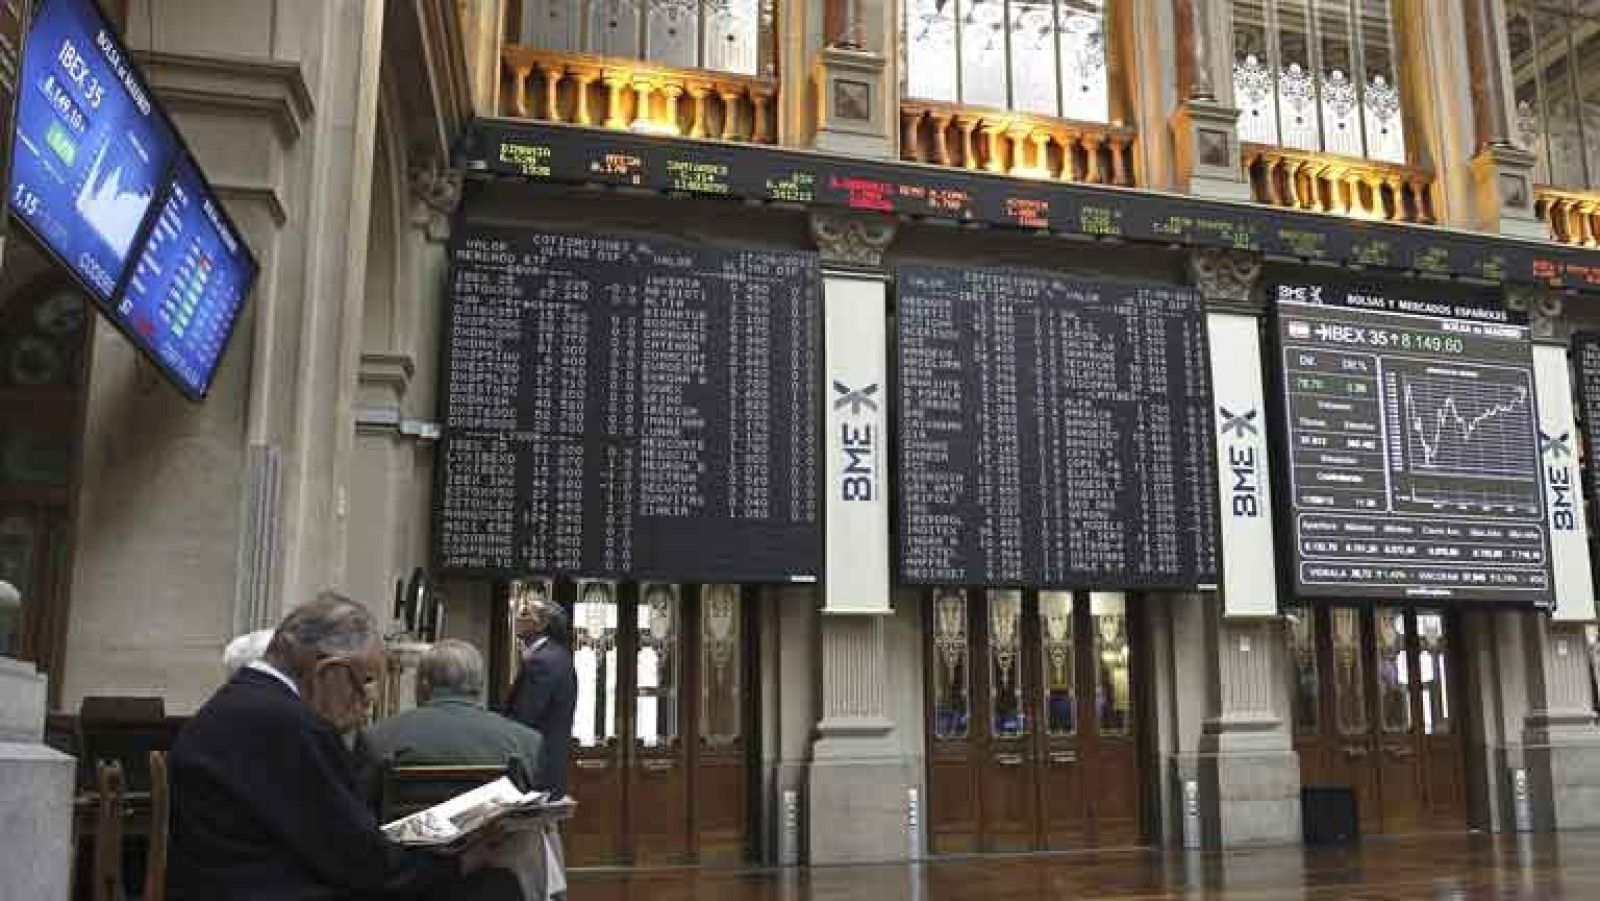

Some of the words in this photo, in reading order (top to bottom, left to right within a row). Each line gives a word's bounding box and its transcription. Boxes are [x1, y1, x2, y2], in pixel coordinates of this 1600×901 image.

[59, 40, 89, 88] IBEX
[86, 79, 104, 109] 35
[1327, 323, 1366, 343] IBEX
[1369, 329, 1389, 345] 35
[842, 423, 871, 501] BME
[1229, 445, 1257, 517] BME
[1550, 466, 1574, 530] BME
